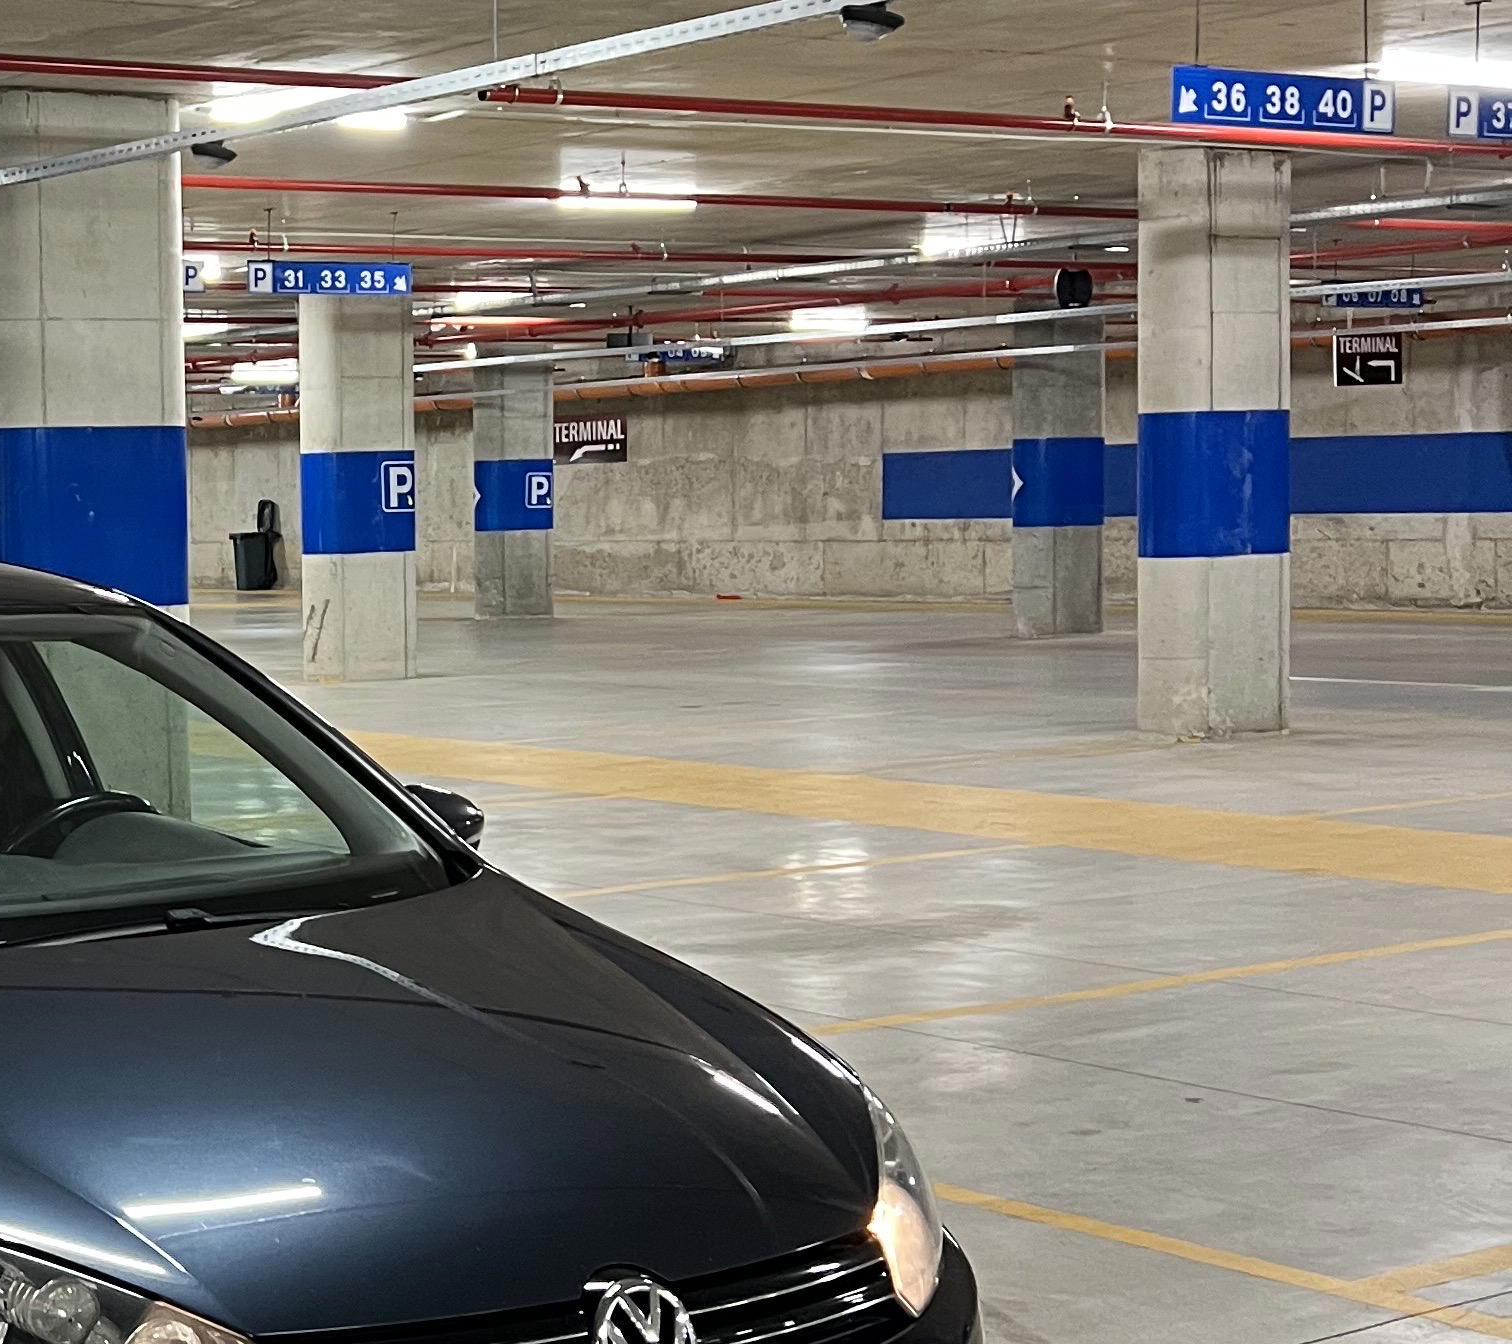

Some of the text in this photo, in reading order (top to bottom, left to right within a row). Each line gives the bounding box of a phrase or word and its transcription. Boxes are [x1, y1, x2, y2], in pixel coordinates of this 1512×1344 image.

[1211, 81, 1386, 122] 36 38 40 P
[1455, 96, 1472, 129] P
[254, 268, 386, 289] P 31 33 35
[1338, 336, 1399, 353] TERMINAL
[554, 419, 625, 443] TERMINAL
[389, 467, 413, 508] P
[531, 476, 549, 505] P
